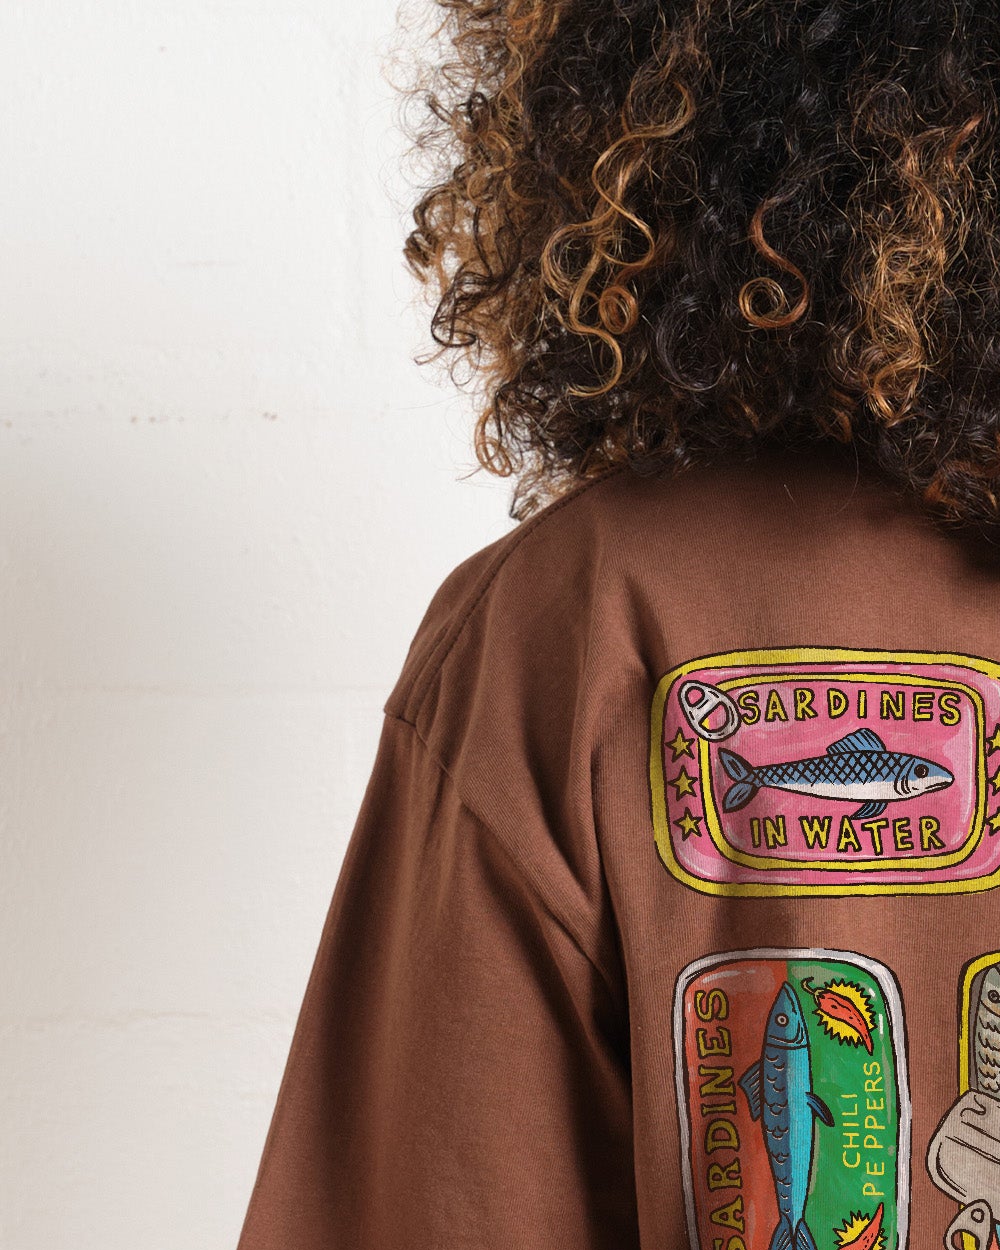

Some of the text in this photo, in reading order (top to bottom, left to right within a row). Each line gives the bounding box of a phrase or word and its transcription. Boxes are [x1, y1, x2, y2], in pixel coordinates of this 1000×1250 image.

[738, 687, 962, 727] SARDINES
[750, 815, 945, 856] IN WATER
[841, 1093, 861, 1169] CHILI
[863, 1061, 885, 1198] PEPPERS
